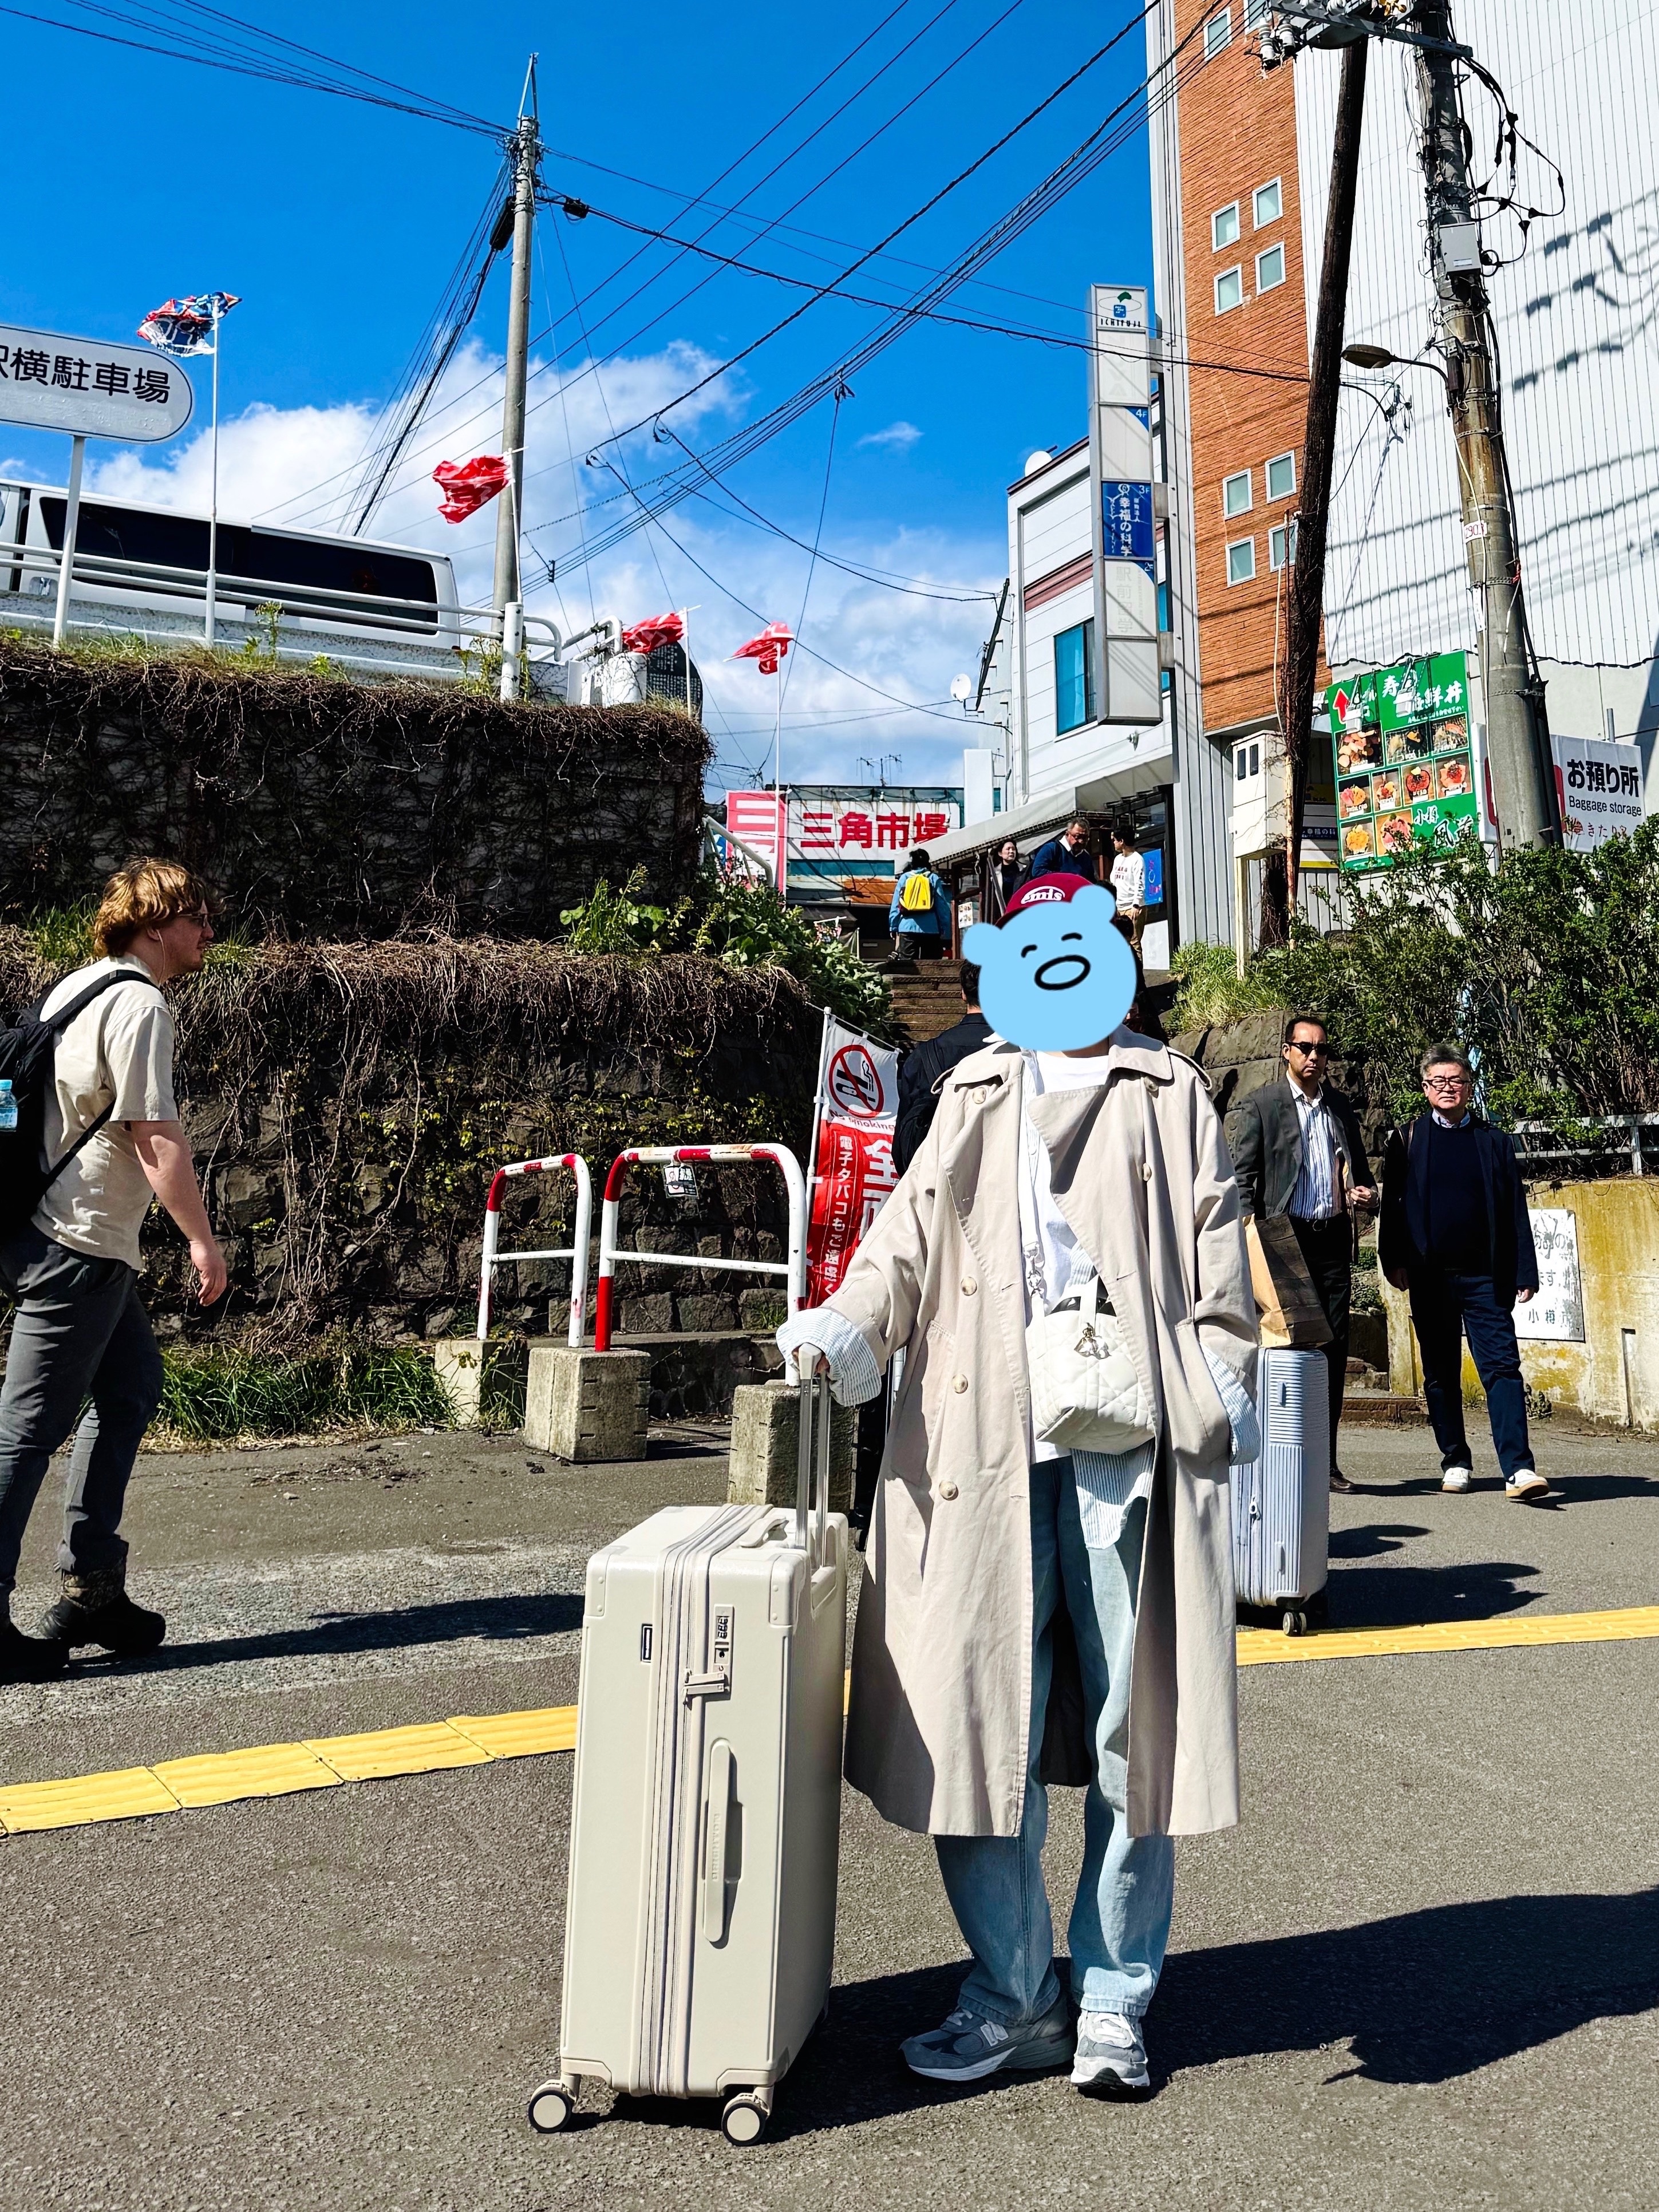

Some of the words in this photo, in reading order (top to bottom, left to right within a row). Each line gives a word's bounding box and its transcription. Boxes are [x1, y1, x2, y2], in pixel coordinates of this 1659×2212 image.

[0, 345, 171, 404] 横駐車場
[1135, 409, 1147, 418] 4F
[1139, 485, 1150, 494] 3F
[1144, 562, 1154, 571] 2F
[1567, 759, 1640, 798] お預り所
[1569, 795, 1607, 813] Baggage
[1609, 801, 1642, 817] storage
[800, 811, 948, 850] 三角市場
